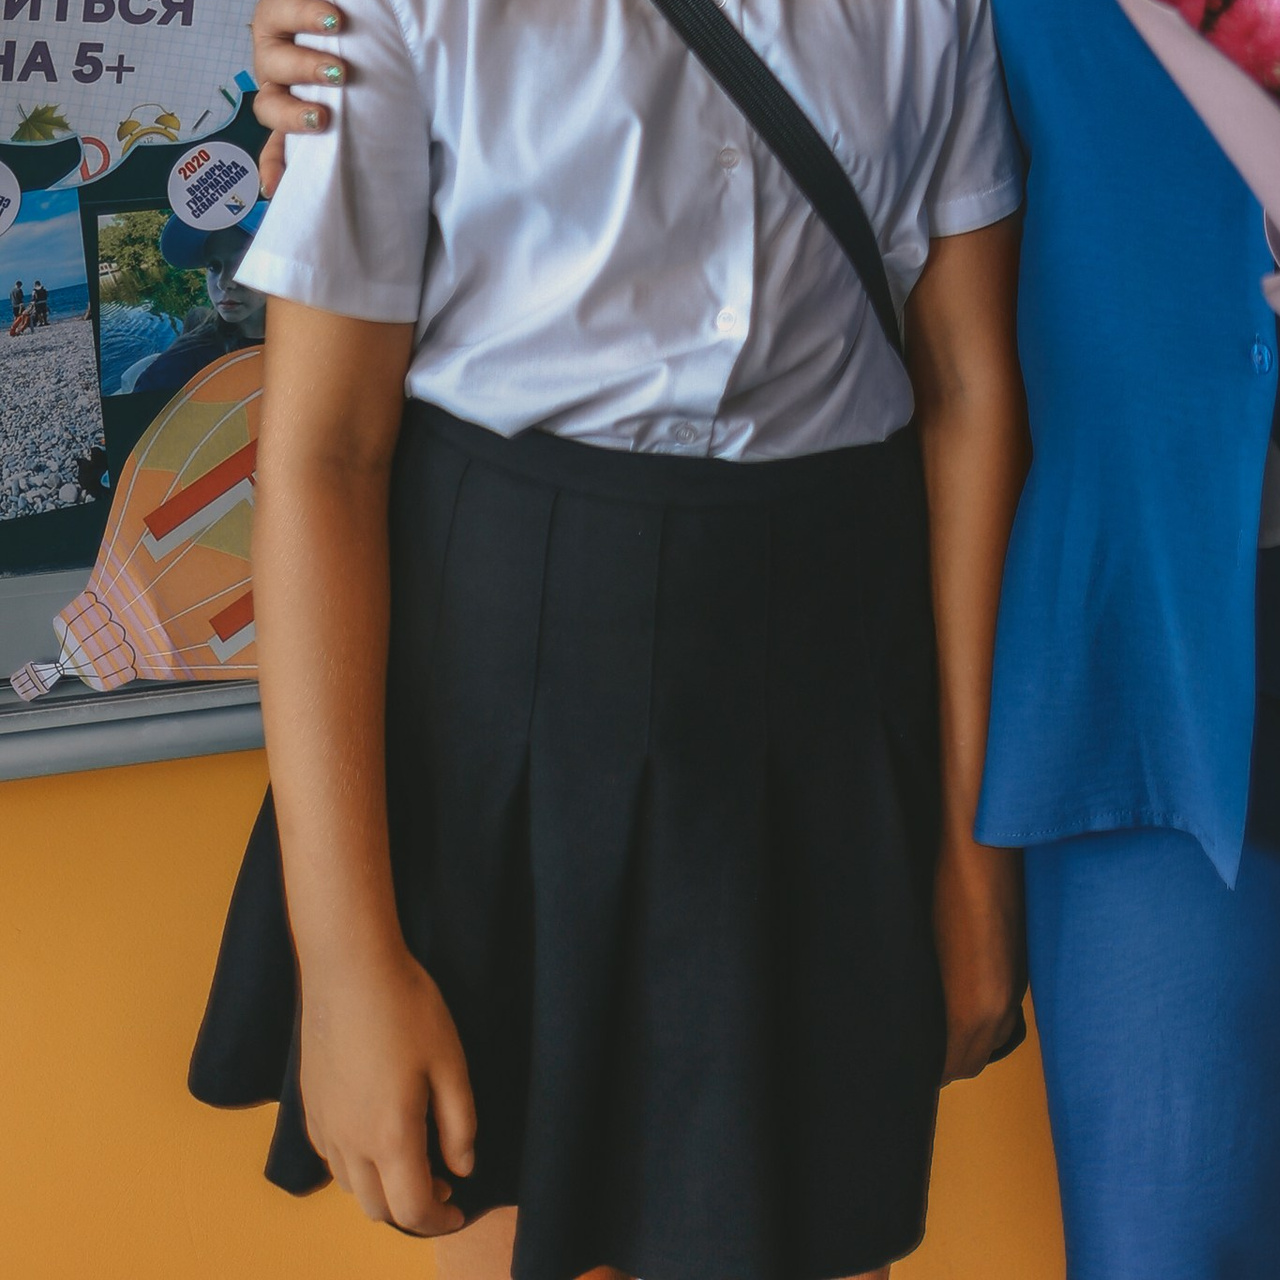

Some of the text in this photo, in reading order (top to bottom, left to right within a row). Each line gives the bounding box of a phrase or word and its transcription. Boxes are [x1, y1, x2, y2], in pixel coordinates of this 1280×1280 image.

[176, 147, 212, 181] 2020
[184, 159, 240, 211] ГУБЕРНАТОРА
[185, 158, 226, 197] ВЫБОРЫ
[190, 164, 249, 219] СЕВАСТОПОЛЯ
